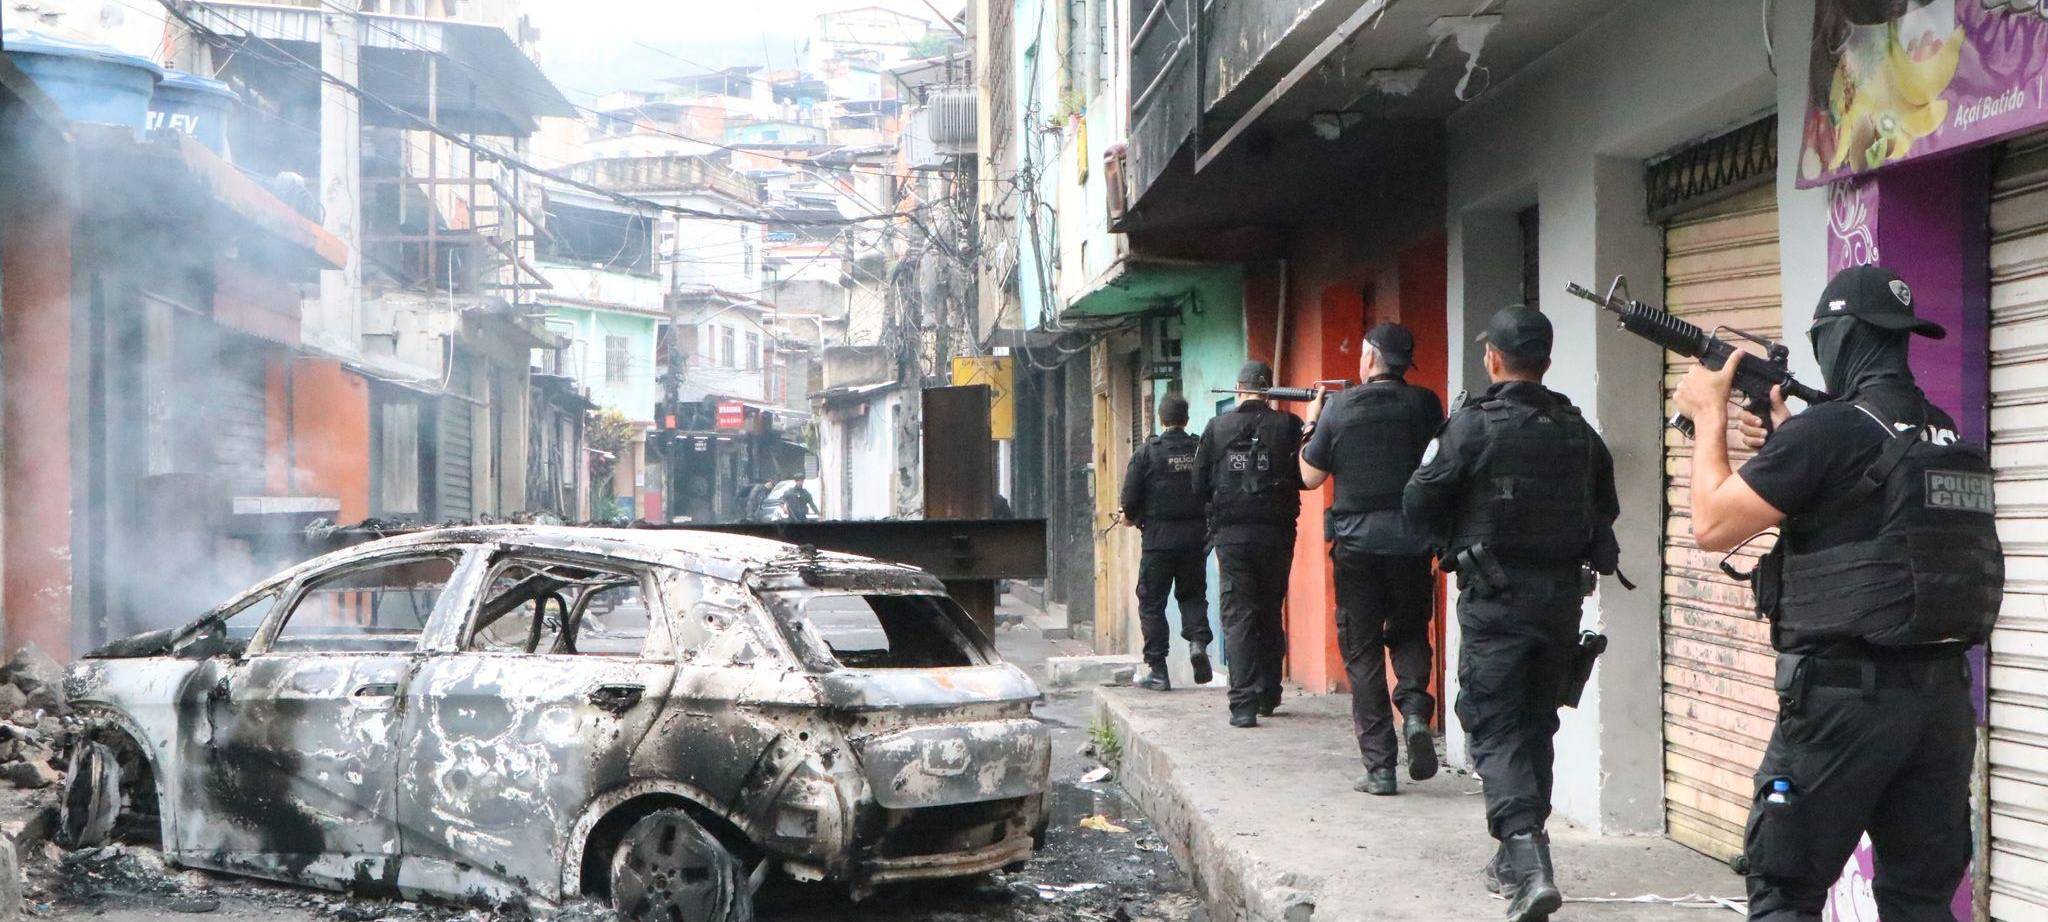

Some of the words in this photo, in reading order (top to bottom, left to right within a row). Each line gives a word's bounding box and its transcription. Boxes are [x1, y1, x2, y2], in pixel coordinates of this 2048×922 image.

[1953, 97, 1982, 131] Açaí
[1982, 86, 2025, 120] Batido
[1229, 453, 1269, 463] POLIA
